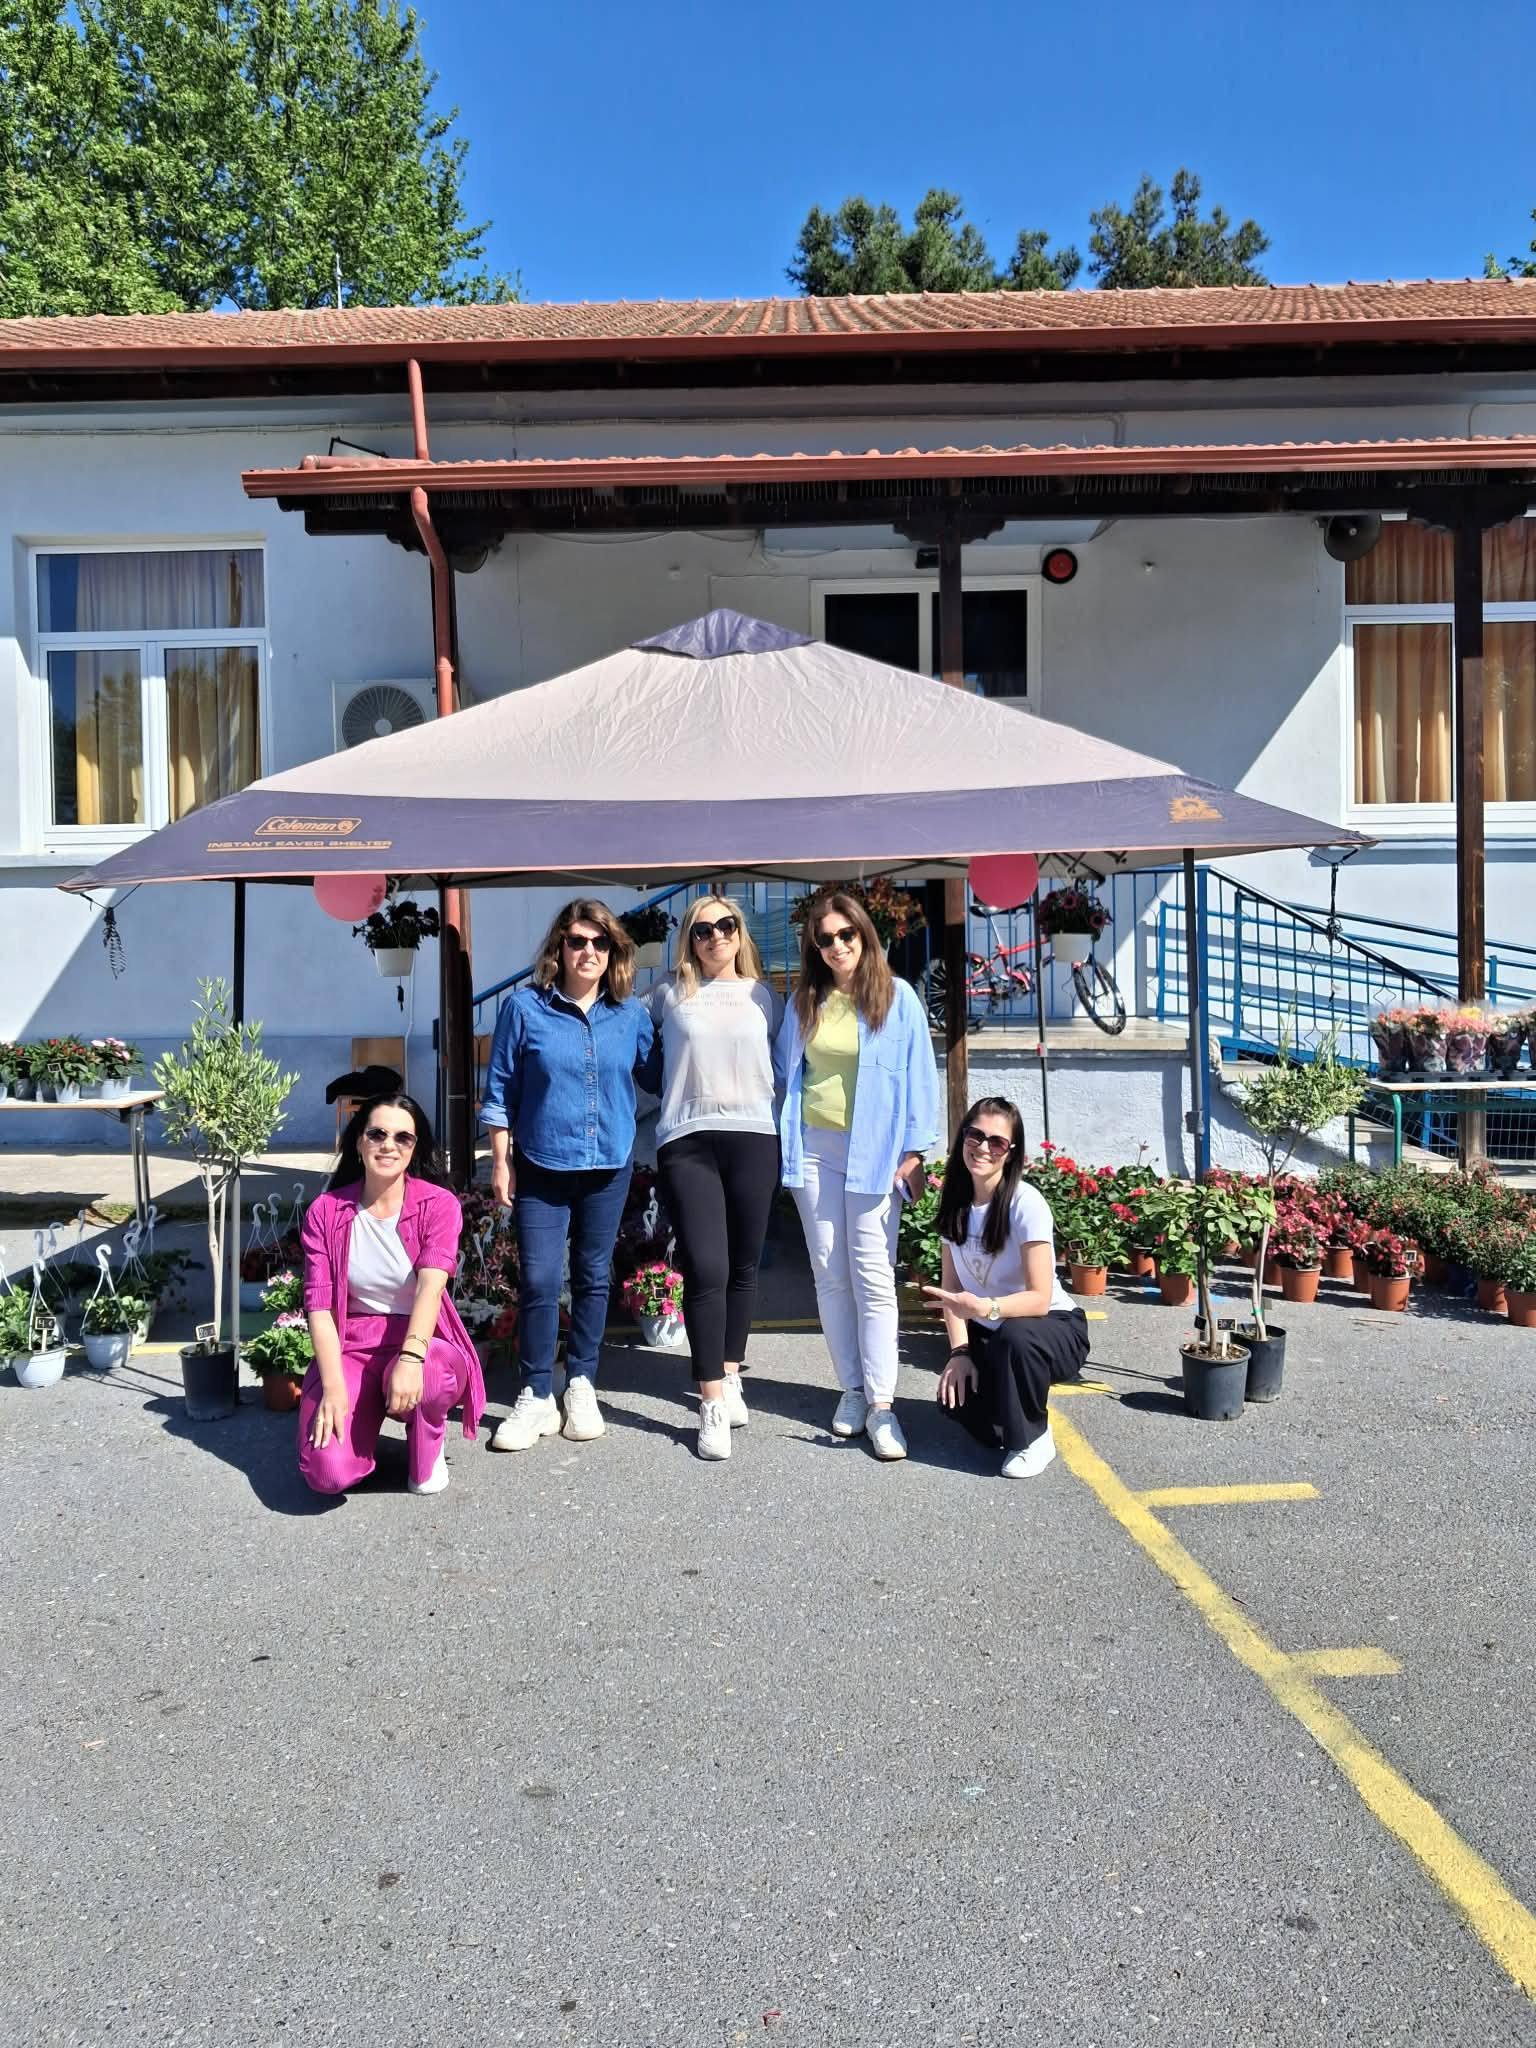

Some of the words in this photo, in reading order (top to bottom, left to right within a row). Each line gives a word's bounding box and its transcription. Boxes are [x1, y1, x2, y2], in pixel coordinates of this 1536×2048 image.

[267, 818, 337, 832] Coleman
[207, 840, 272, 848] INSTANT
[328, 840, 393, 848] SHELTER
